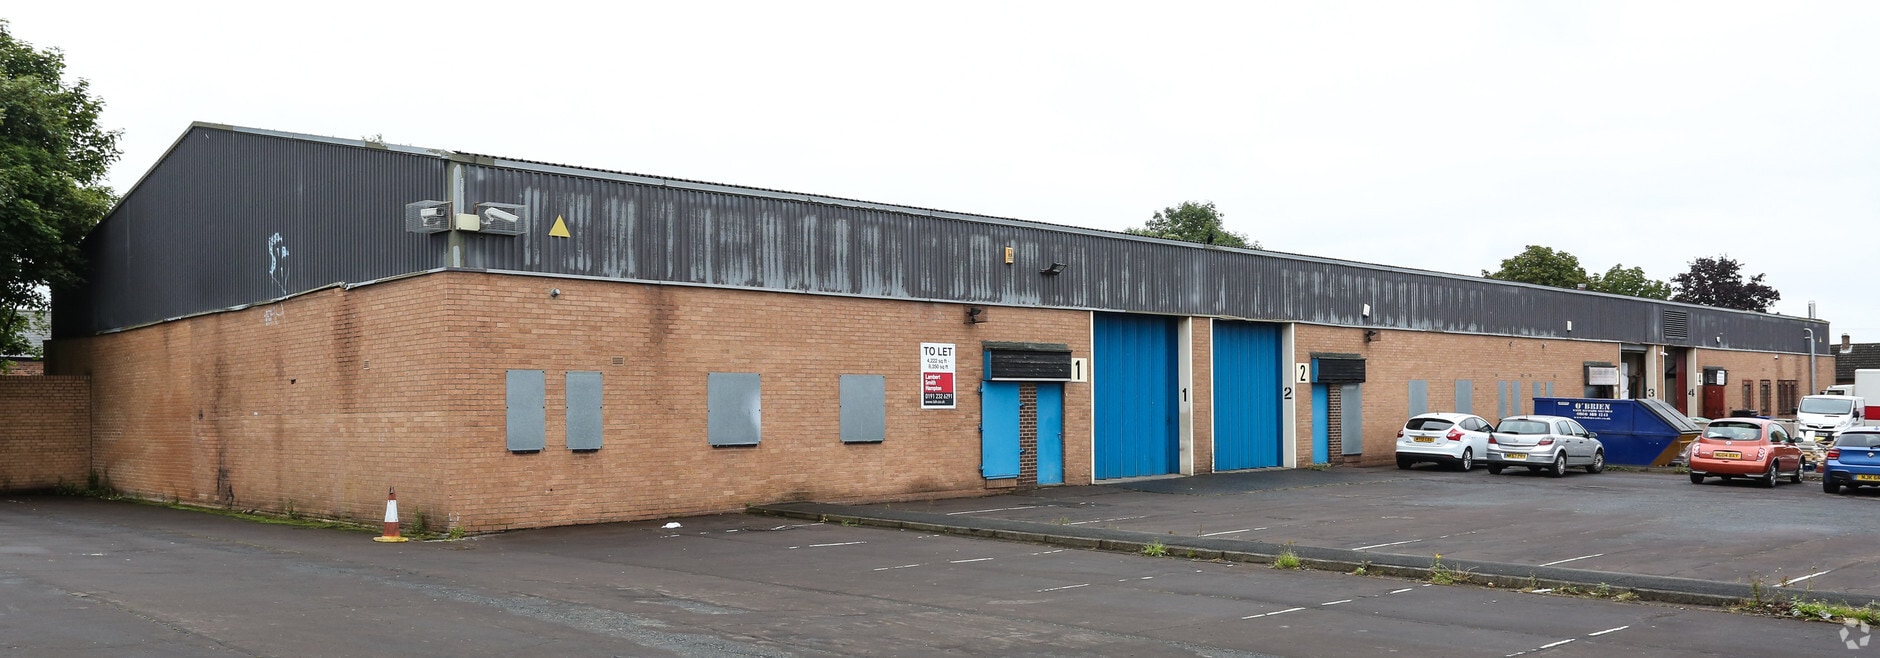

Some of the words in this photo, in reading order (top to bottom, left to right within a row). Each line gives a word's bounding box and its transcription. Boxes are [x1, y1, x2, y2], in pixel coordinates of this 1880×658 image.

[924, 346, 936, 356] TO
[938, 347, 952, 356] LET
[1075, 360, 1080, 380] 1
[1300, 365, 1306, 382] 2
[1182, 388, 1187, 402] 1
[1284, 387, 1292, 400] 2
[1648, 388, 1655, 397] 3
[1688, 388, 1695, 397] 4
